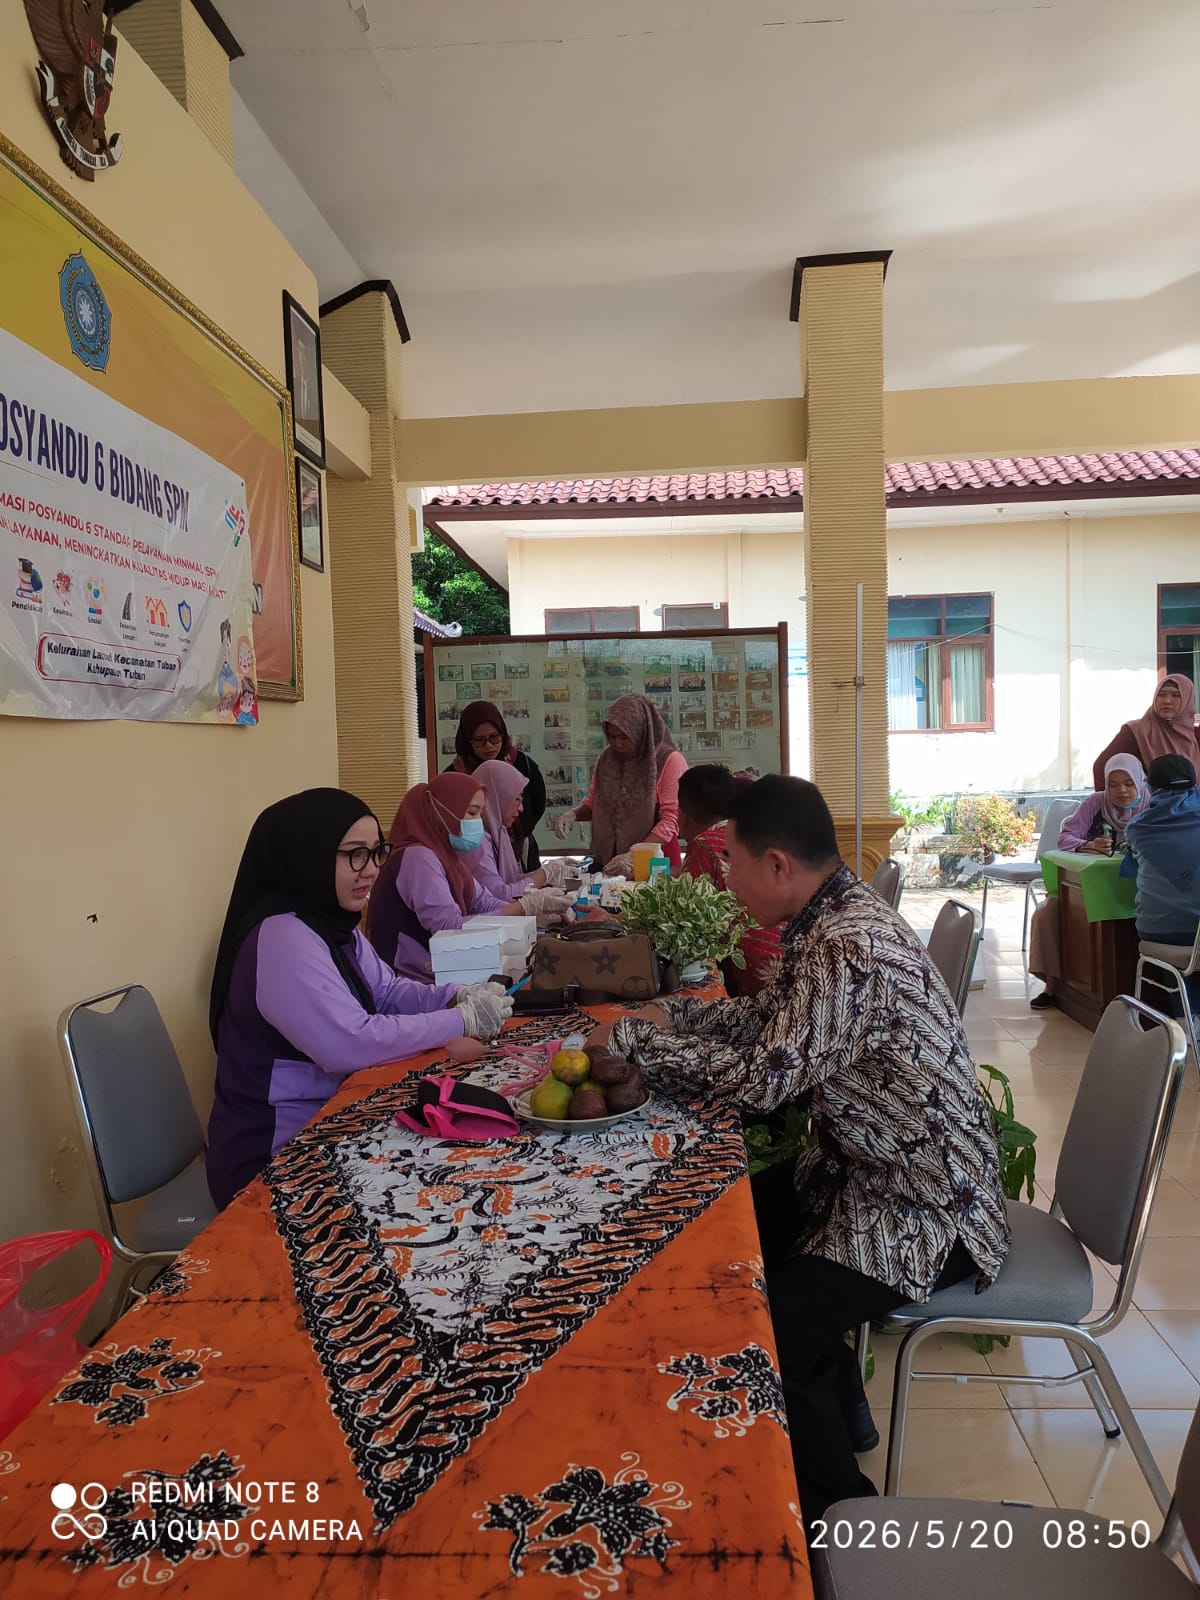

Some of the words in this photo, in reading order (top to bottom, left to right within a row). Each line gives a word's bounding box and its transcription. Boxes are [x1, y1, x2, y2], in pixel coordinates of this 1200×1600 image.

[94, 441, 105, 492] 6
[109, 448, 163, 519] BIDANG
[163, 480, 190, 532] SPM
[28, 501, 84, 531] POSYANDU
[86, 521, 92, 534] 6
[93, 523, 130, 547] STANDAR
[132, 538, 173, 564] PELAYANAN
[173, 555, 204, 574] MINIMAL
[64, 536, 131, 570] MENINGKATKAN
[132, 559, 168, 581] KUALITAS
[47, 642, 91, 659] Kelurahan
[157, 660, 177, 671] Tuban
